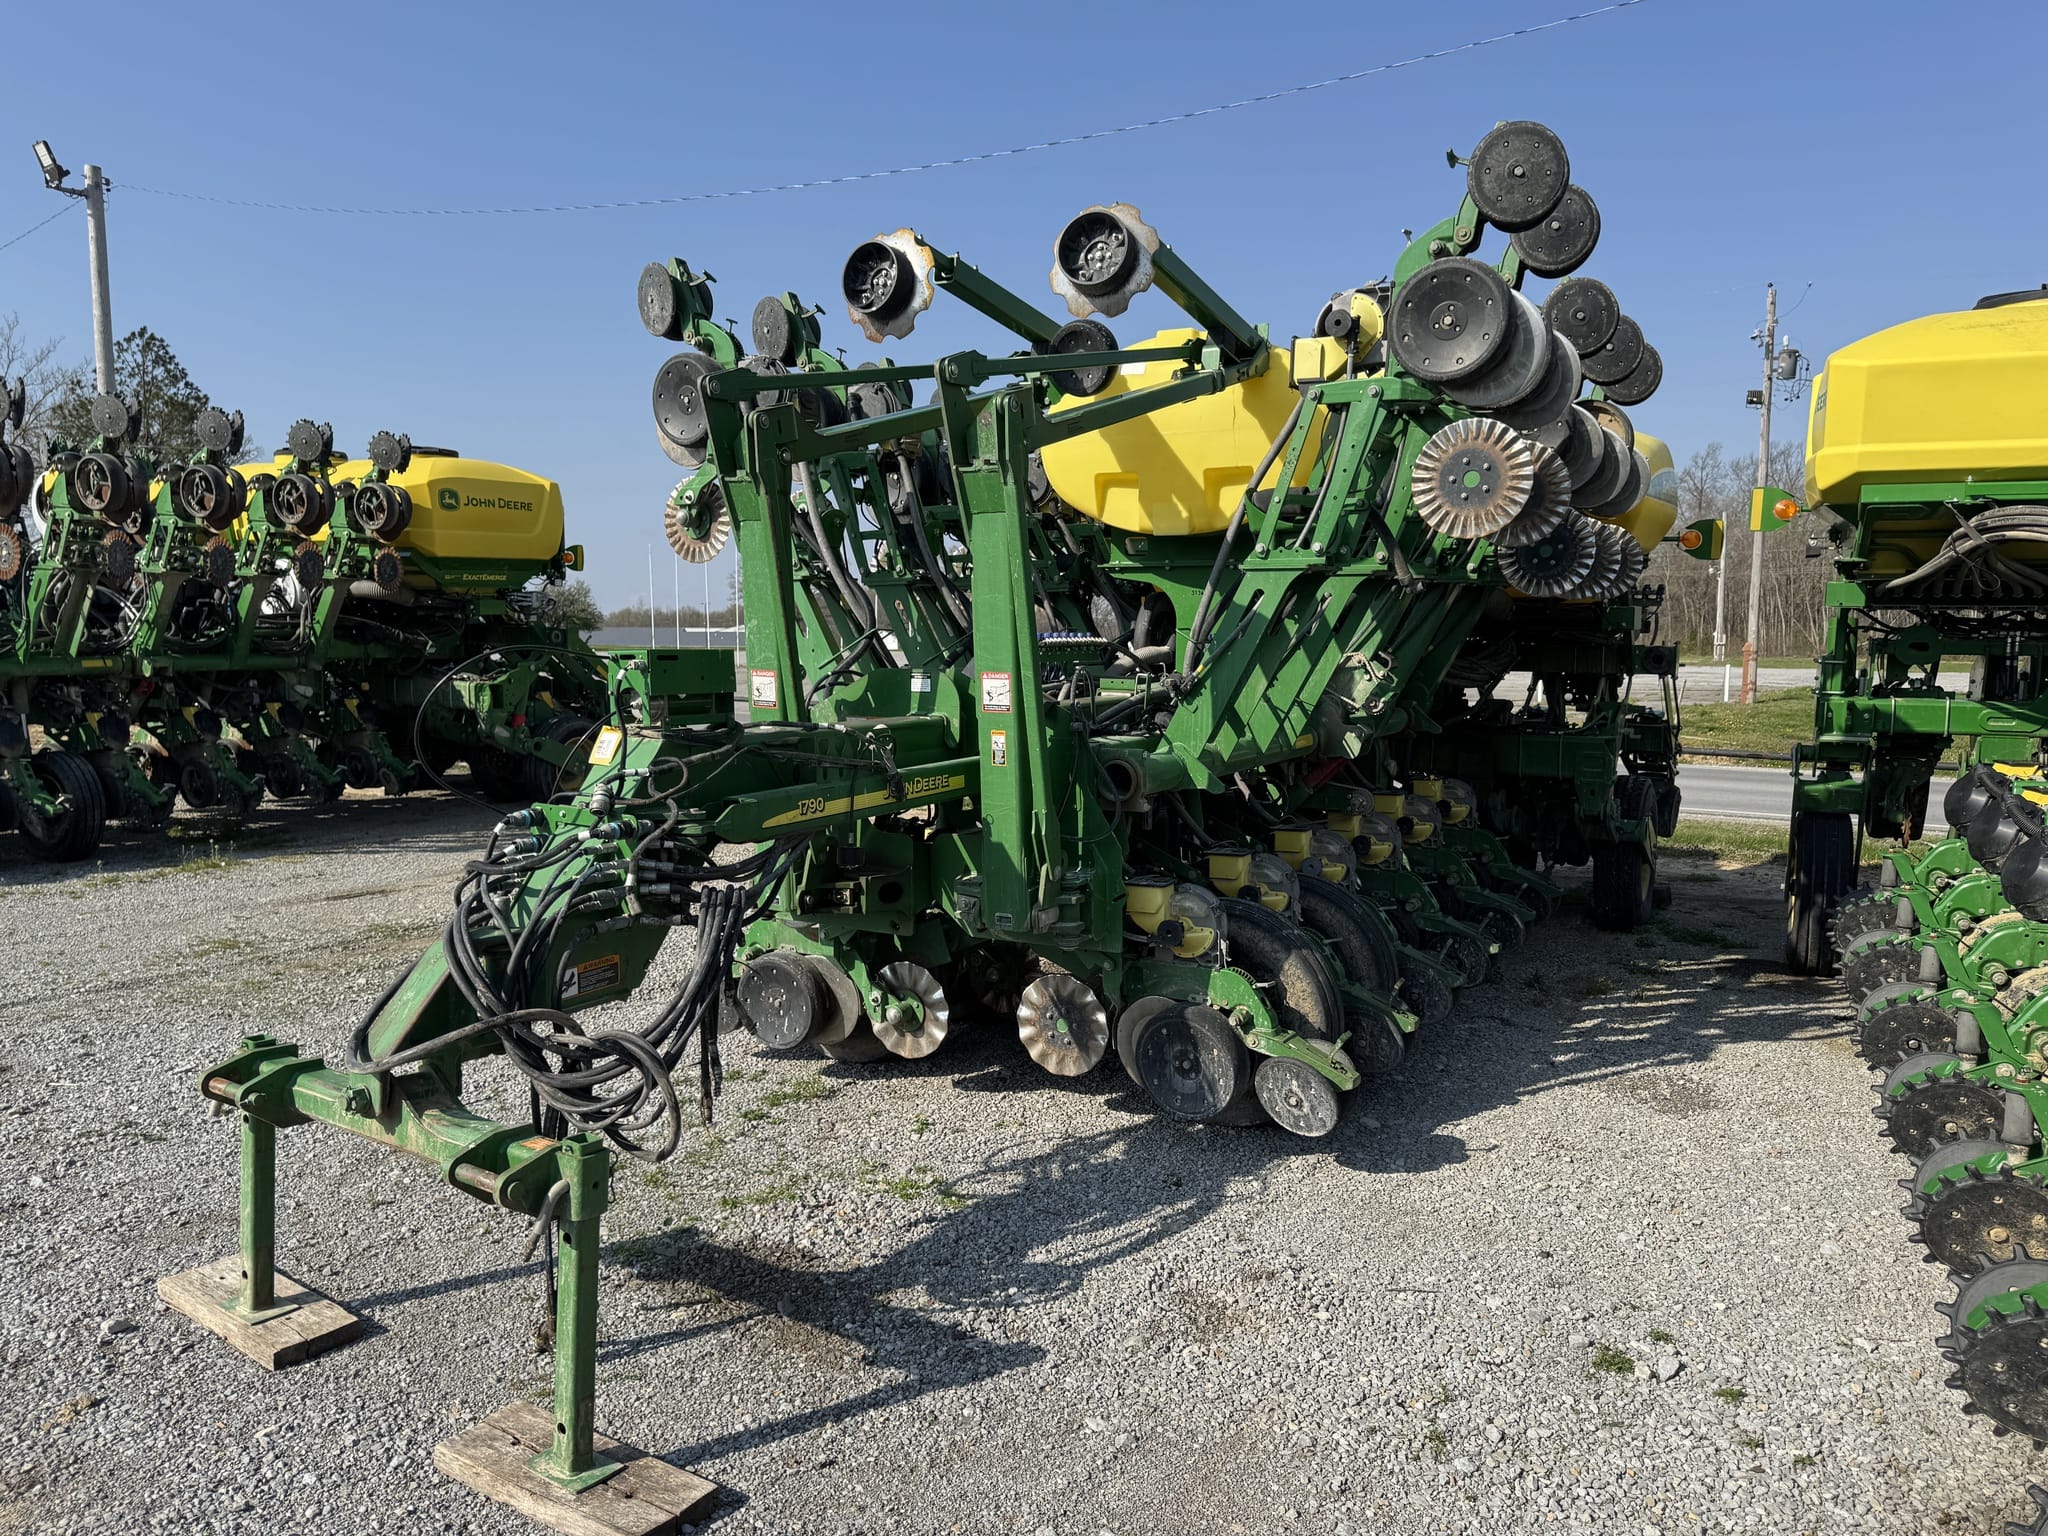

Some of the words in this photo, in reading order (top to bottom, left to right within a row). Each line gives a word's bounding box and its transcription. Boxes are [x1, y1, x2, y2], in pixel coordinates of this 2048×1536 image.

[463, 495, 495, 508] JOHN
[498, 498, 533, 511] DEERE
[914, 774, 949, 792] DEERE
[798, 797, 825, 816] 1790
